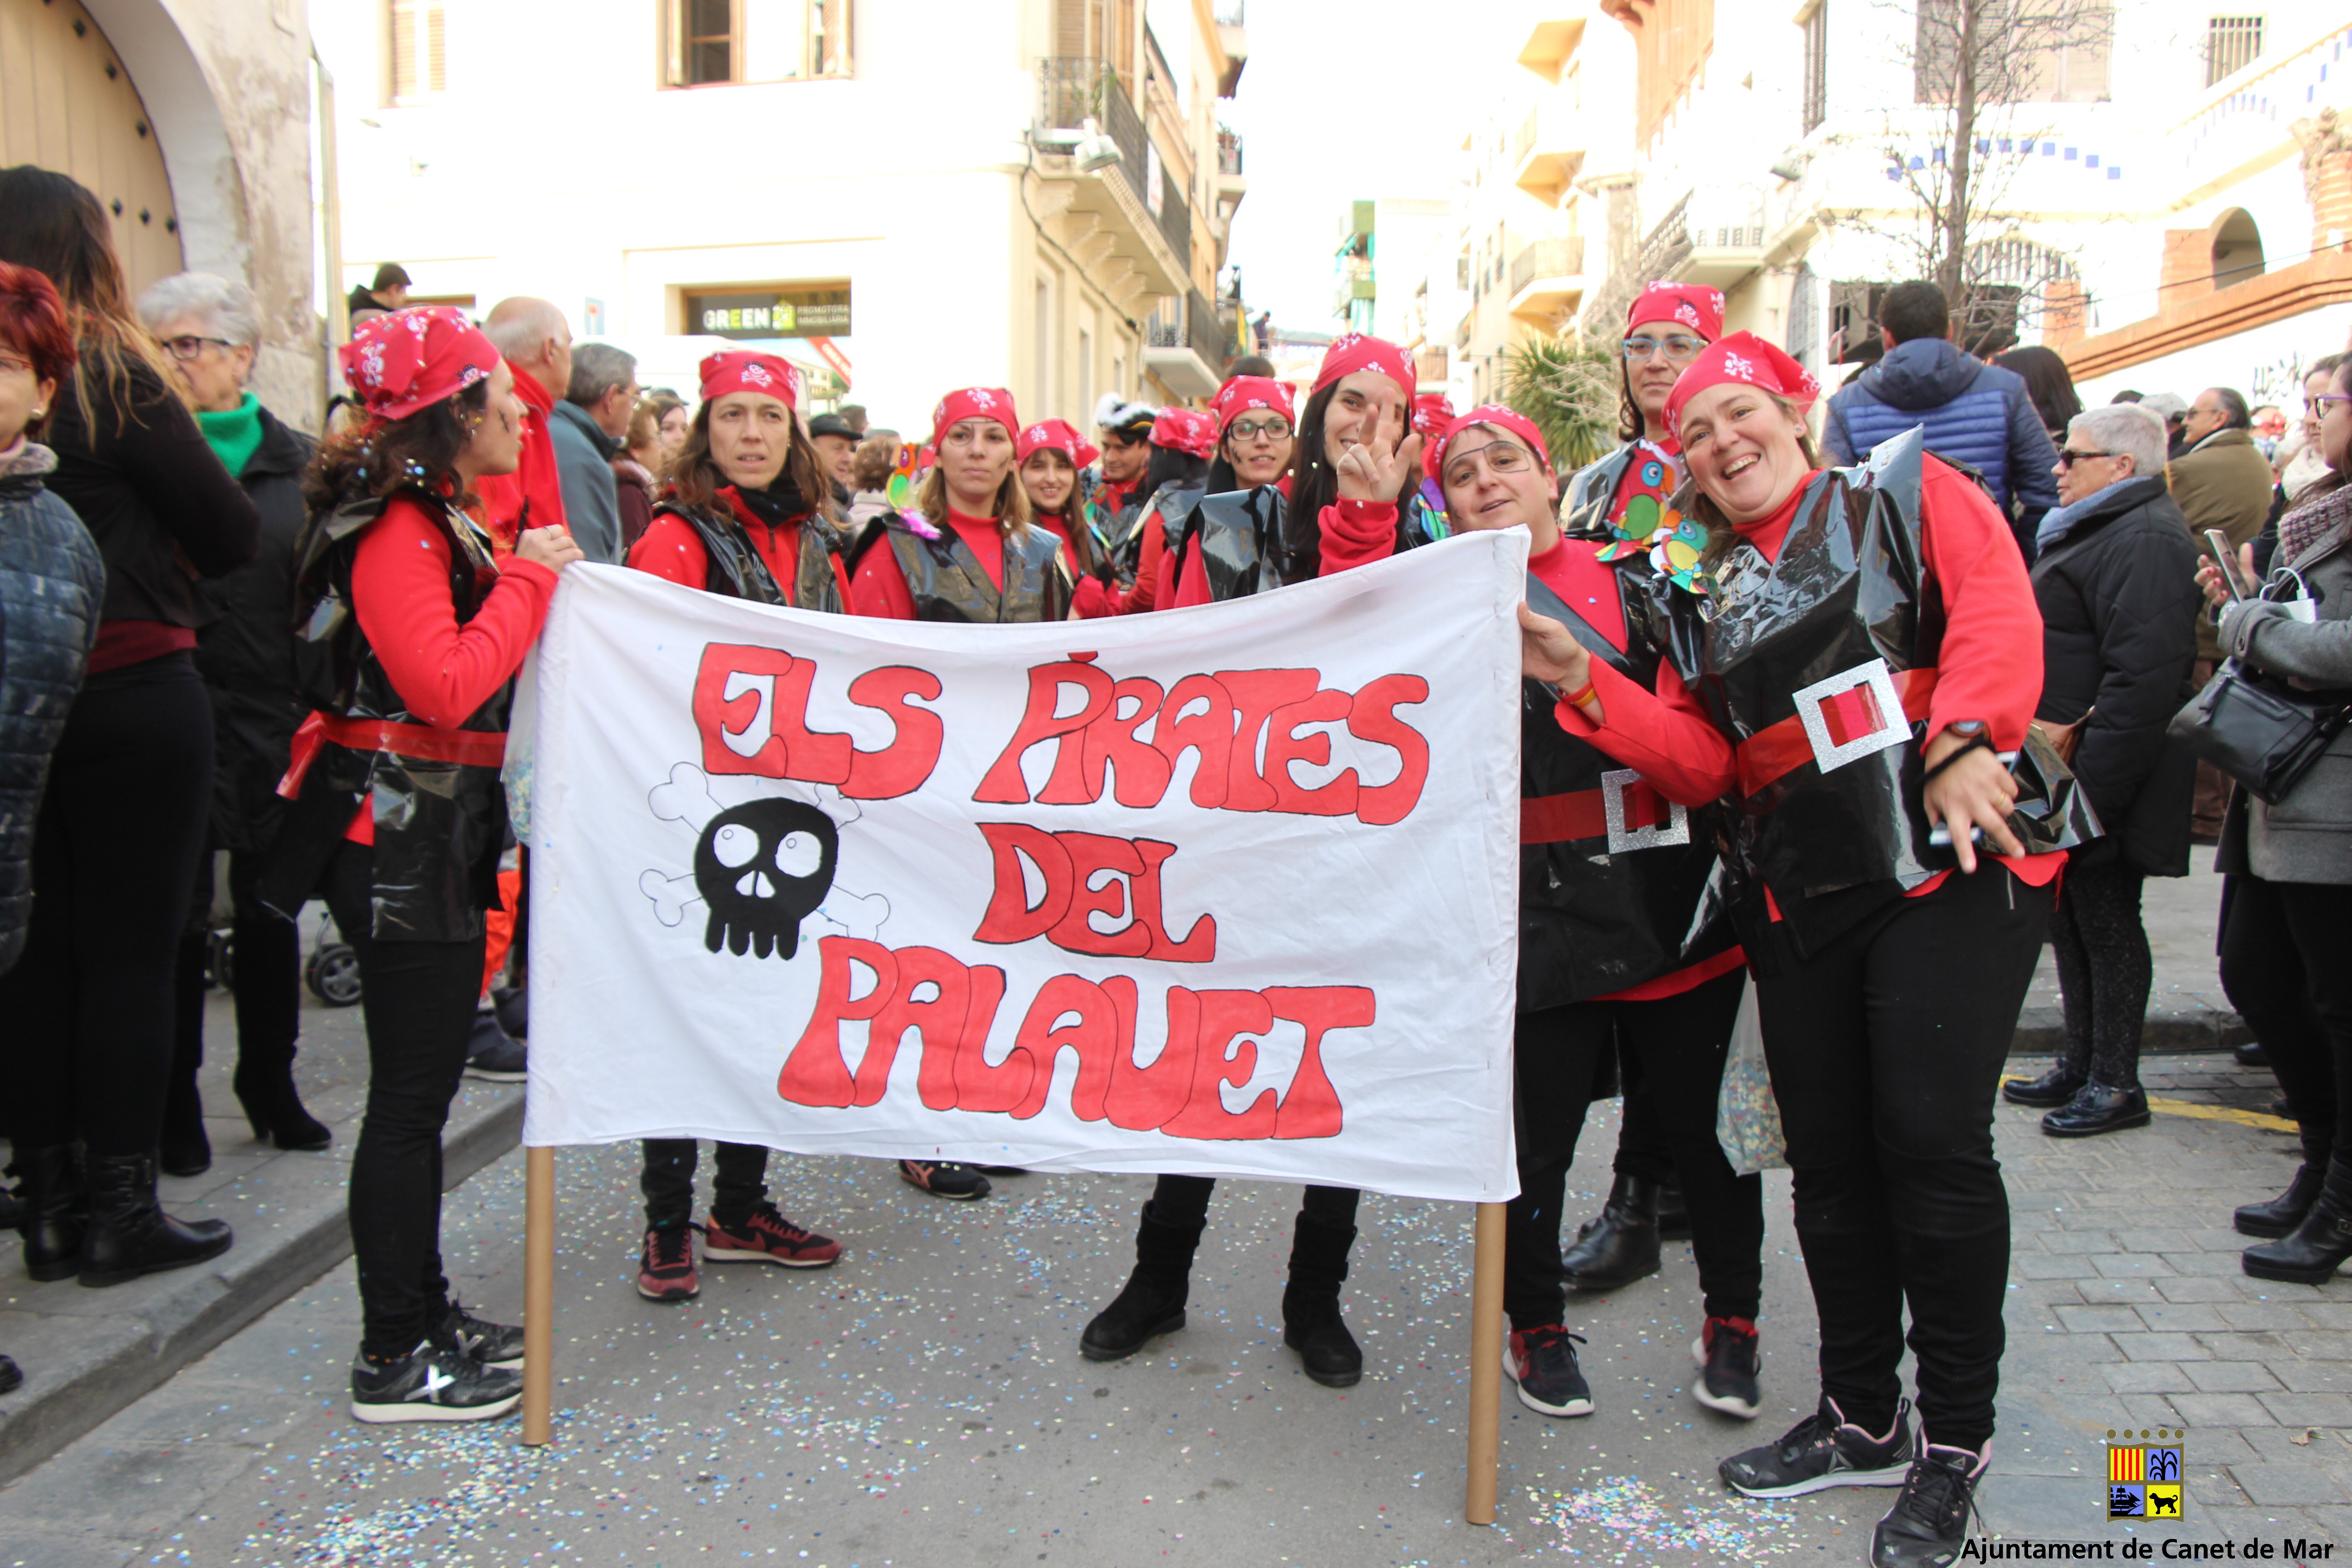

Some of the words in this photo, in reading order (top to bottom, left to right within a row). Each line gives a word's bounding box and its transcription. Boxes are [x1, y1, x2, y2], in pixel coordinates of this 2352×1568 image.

[703, 307, 770, 329] GREEN
[797, 305, 848, 314] PROMOTORA
[822, 343, 842, 366] OBRA
[692, 642, 944, 800] ELS
[972, 651, 1430, 825] PIRATES
[972, 822, 1217, 963] DEL
[777, 935, 1377, 1141] PALAUET
